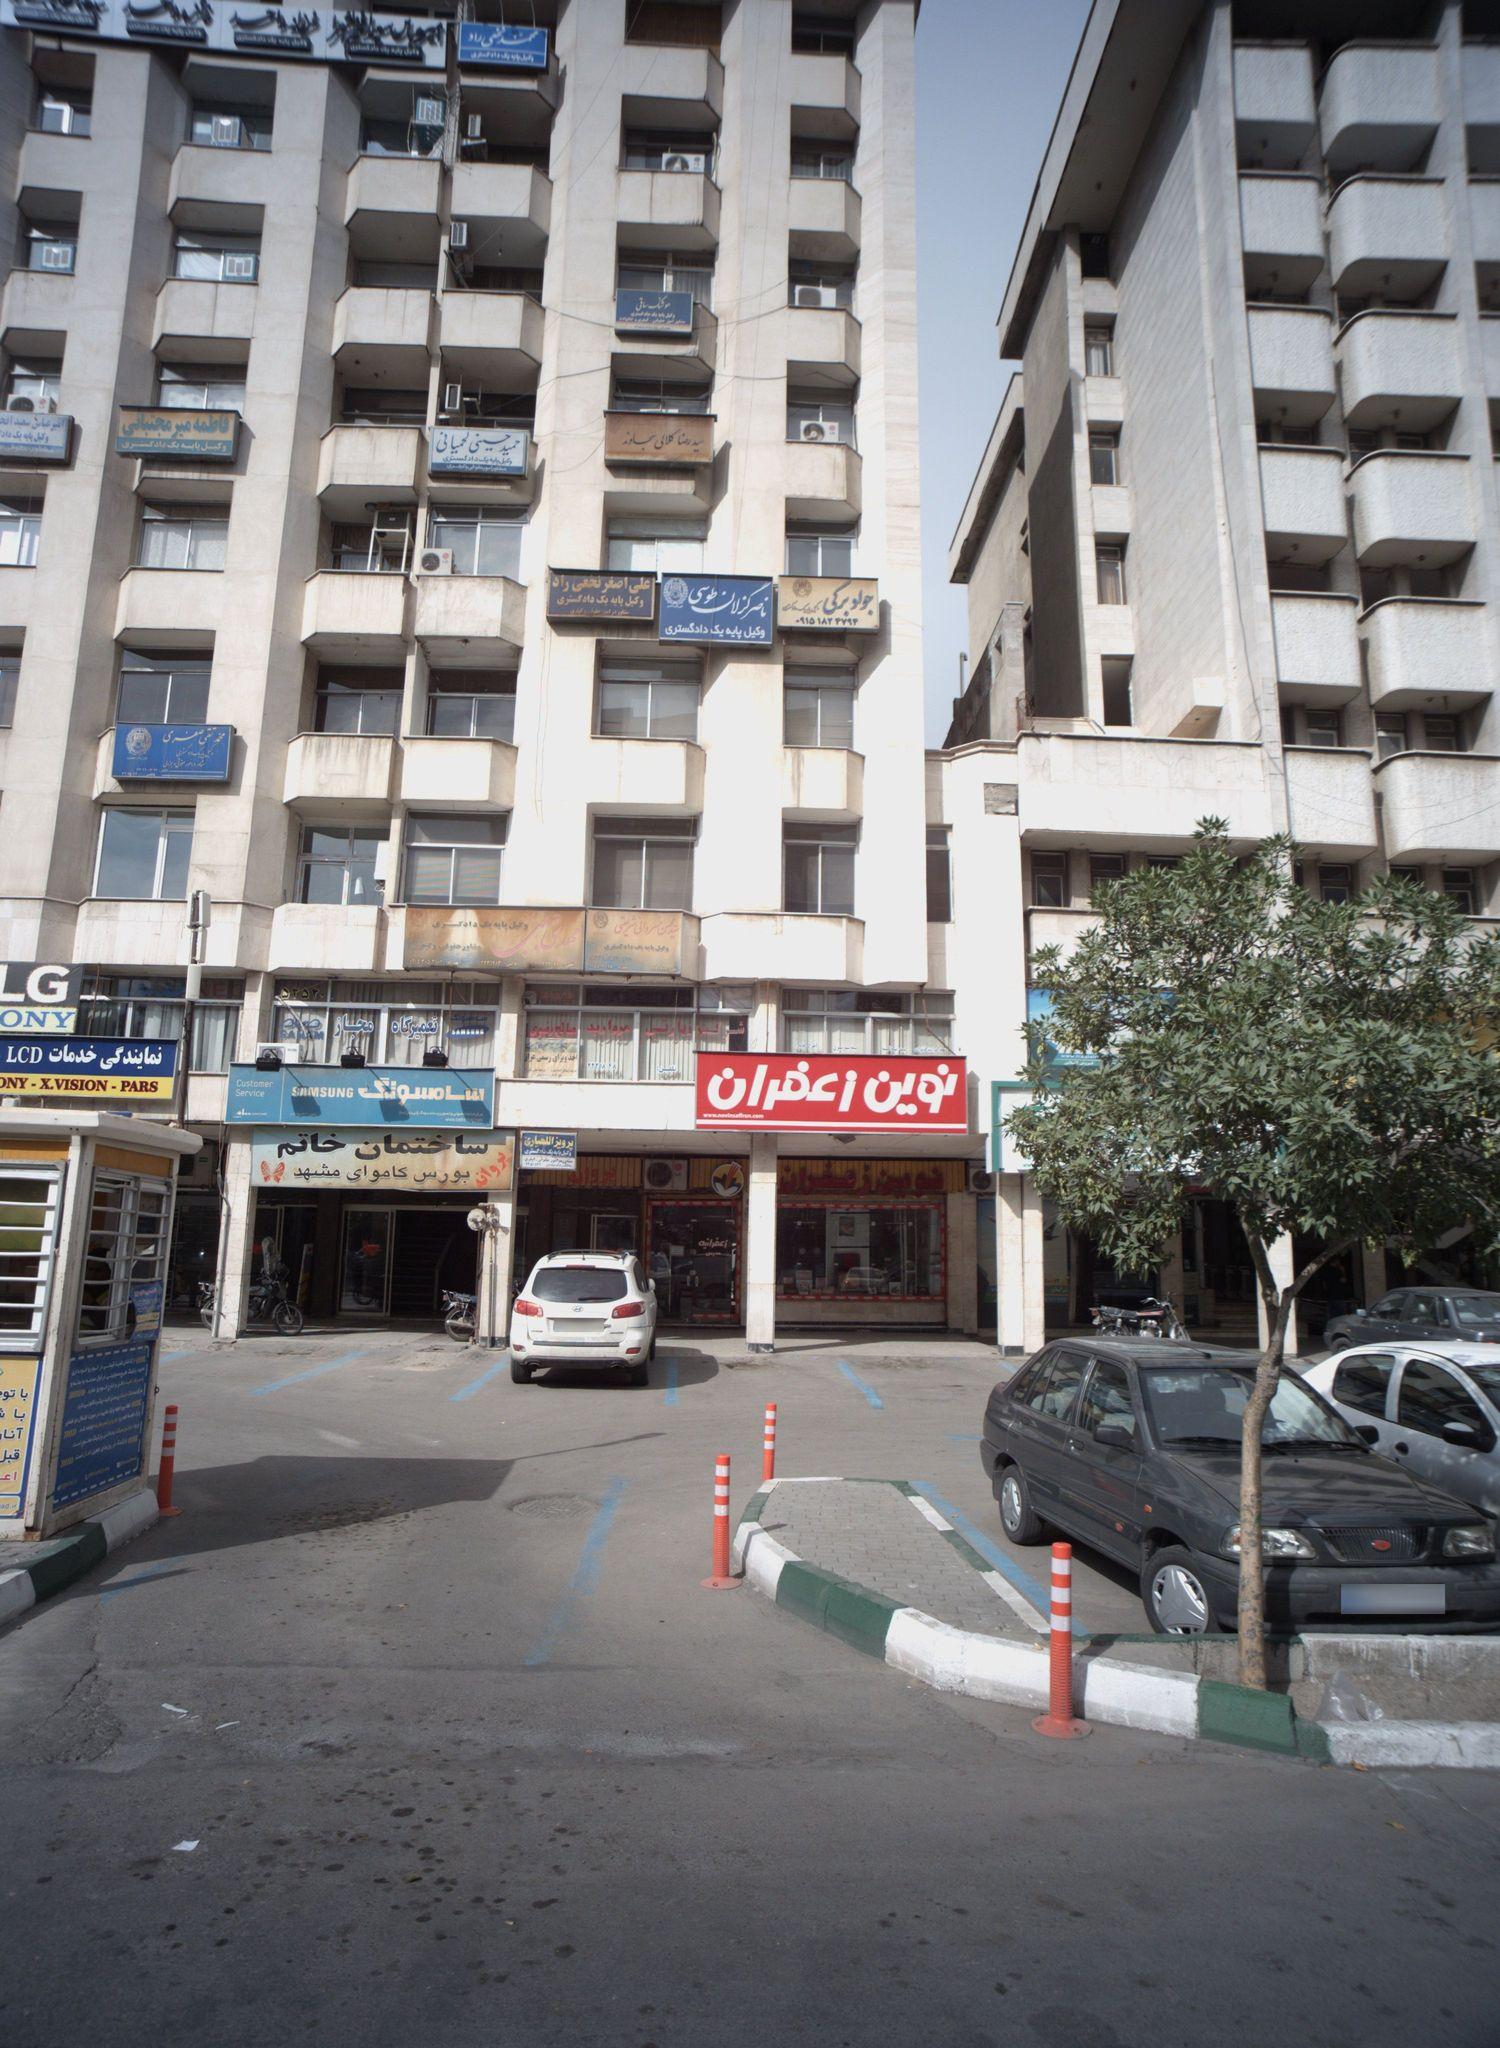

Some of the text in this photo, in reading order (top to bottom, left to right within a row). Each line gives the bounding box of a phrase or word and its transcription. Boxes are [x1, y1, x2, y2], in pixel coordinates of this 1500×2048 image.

[629, 576, 650, 593] علی
[688, 585, 718, 605] طوسی
[665, 623, 766, 639] وکیل پایه یک دادگستری
[0, 964, 70, 1003] LG
[0, 1010, 75, 1028] ONY
[334, 1013, 439, 1040] تعمیرگاه مجاز
[6, 1044, 163, 1070] نمایندگی خدمات LCD
[0, 1076, 159, 1093] ONY X.VISION PARS
[236, 1079, 274, 1088] Customer
[358, 1077, 485, 1105] سامسونگ
[707, 1060, 959, 1115] نوین زعفران
[235, 1089, 265, 1098] Service
[291, 1087, 354, 1099] SAMSUNG
[277, 1133, 489, 1160] ساختمان خاتم
[294, 1162, 470, 1186] بورس کاموای مشهد
[20, 1388, 28, 1401] با
[0, 1427, 24, 1439] آنا
[0, 1471, 17, 1481] اع
